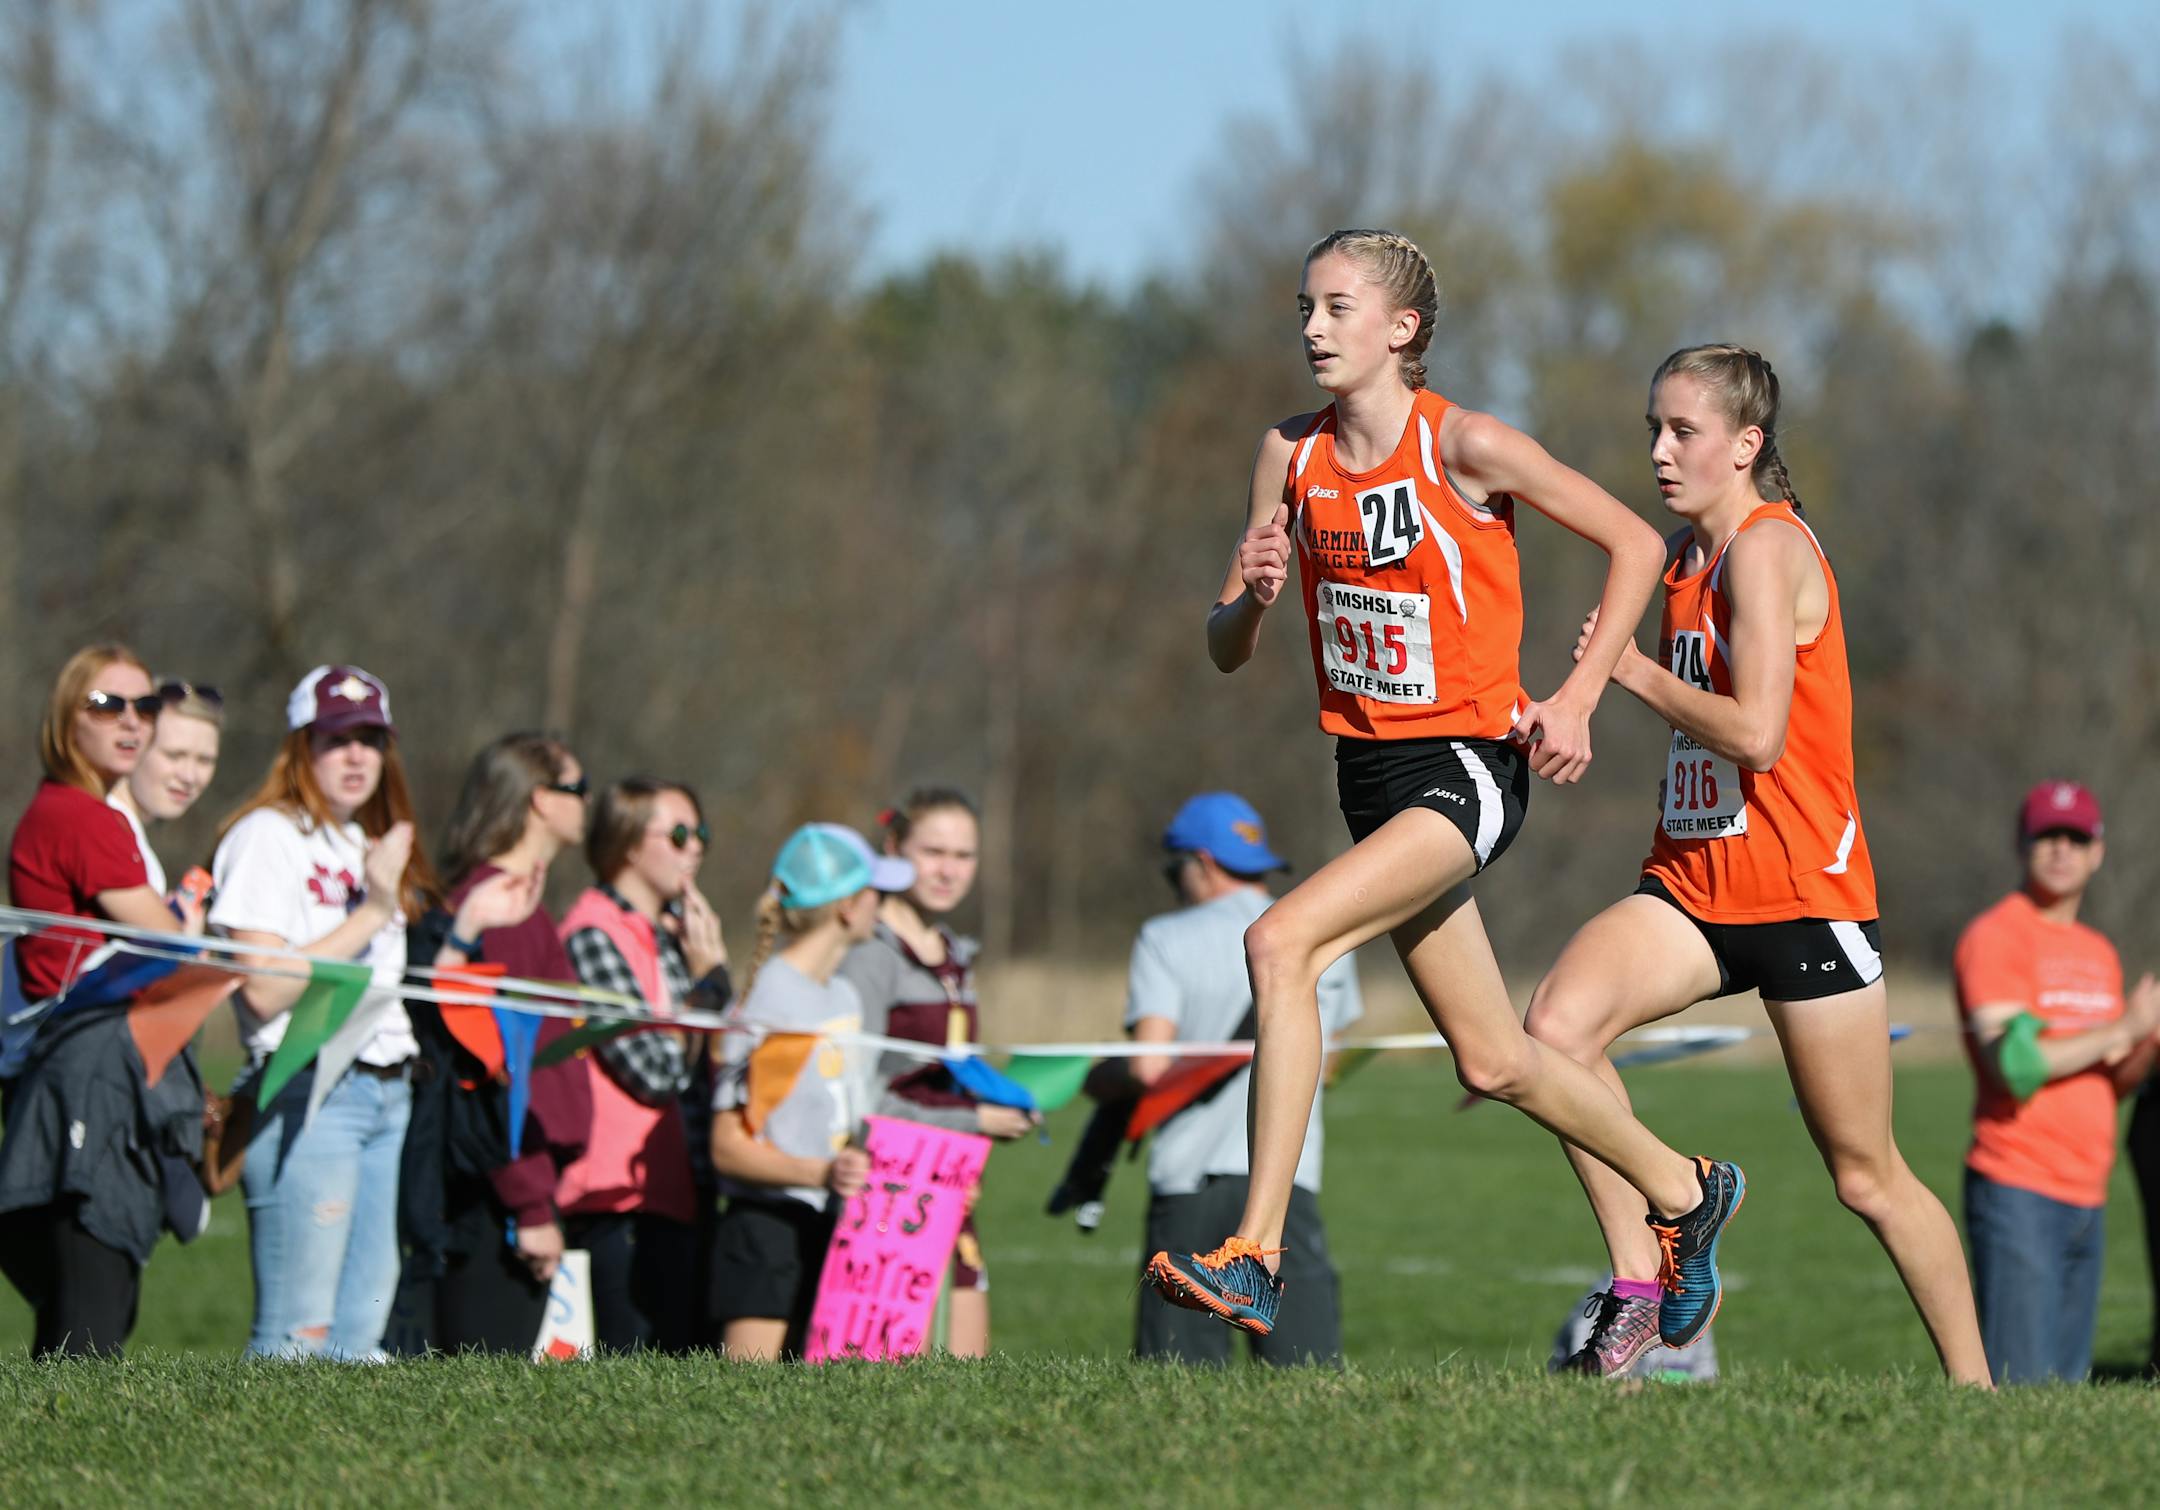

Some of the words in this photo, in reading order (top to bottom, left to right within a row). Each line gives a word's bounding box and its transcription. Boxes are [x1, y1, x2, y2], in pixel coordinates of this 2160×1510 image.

[1362, 486, 1421, 561] 24
[1335, 590, 1398, 615] MSHSL
[1334, 615, 1408, 676] 915
[1675, 634, 1711, 692] 24
[1330, 668, 1373, 690] STATE
[1377, 680, 1425, 697] MEET
[1673, 759, 1719, 810] 916
[1666, 818, 1694, 833] STATE
[1697, 814, 1737, 831] MEET
